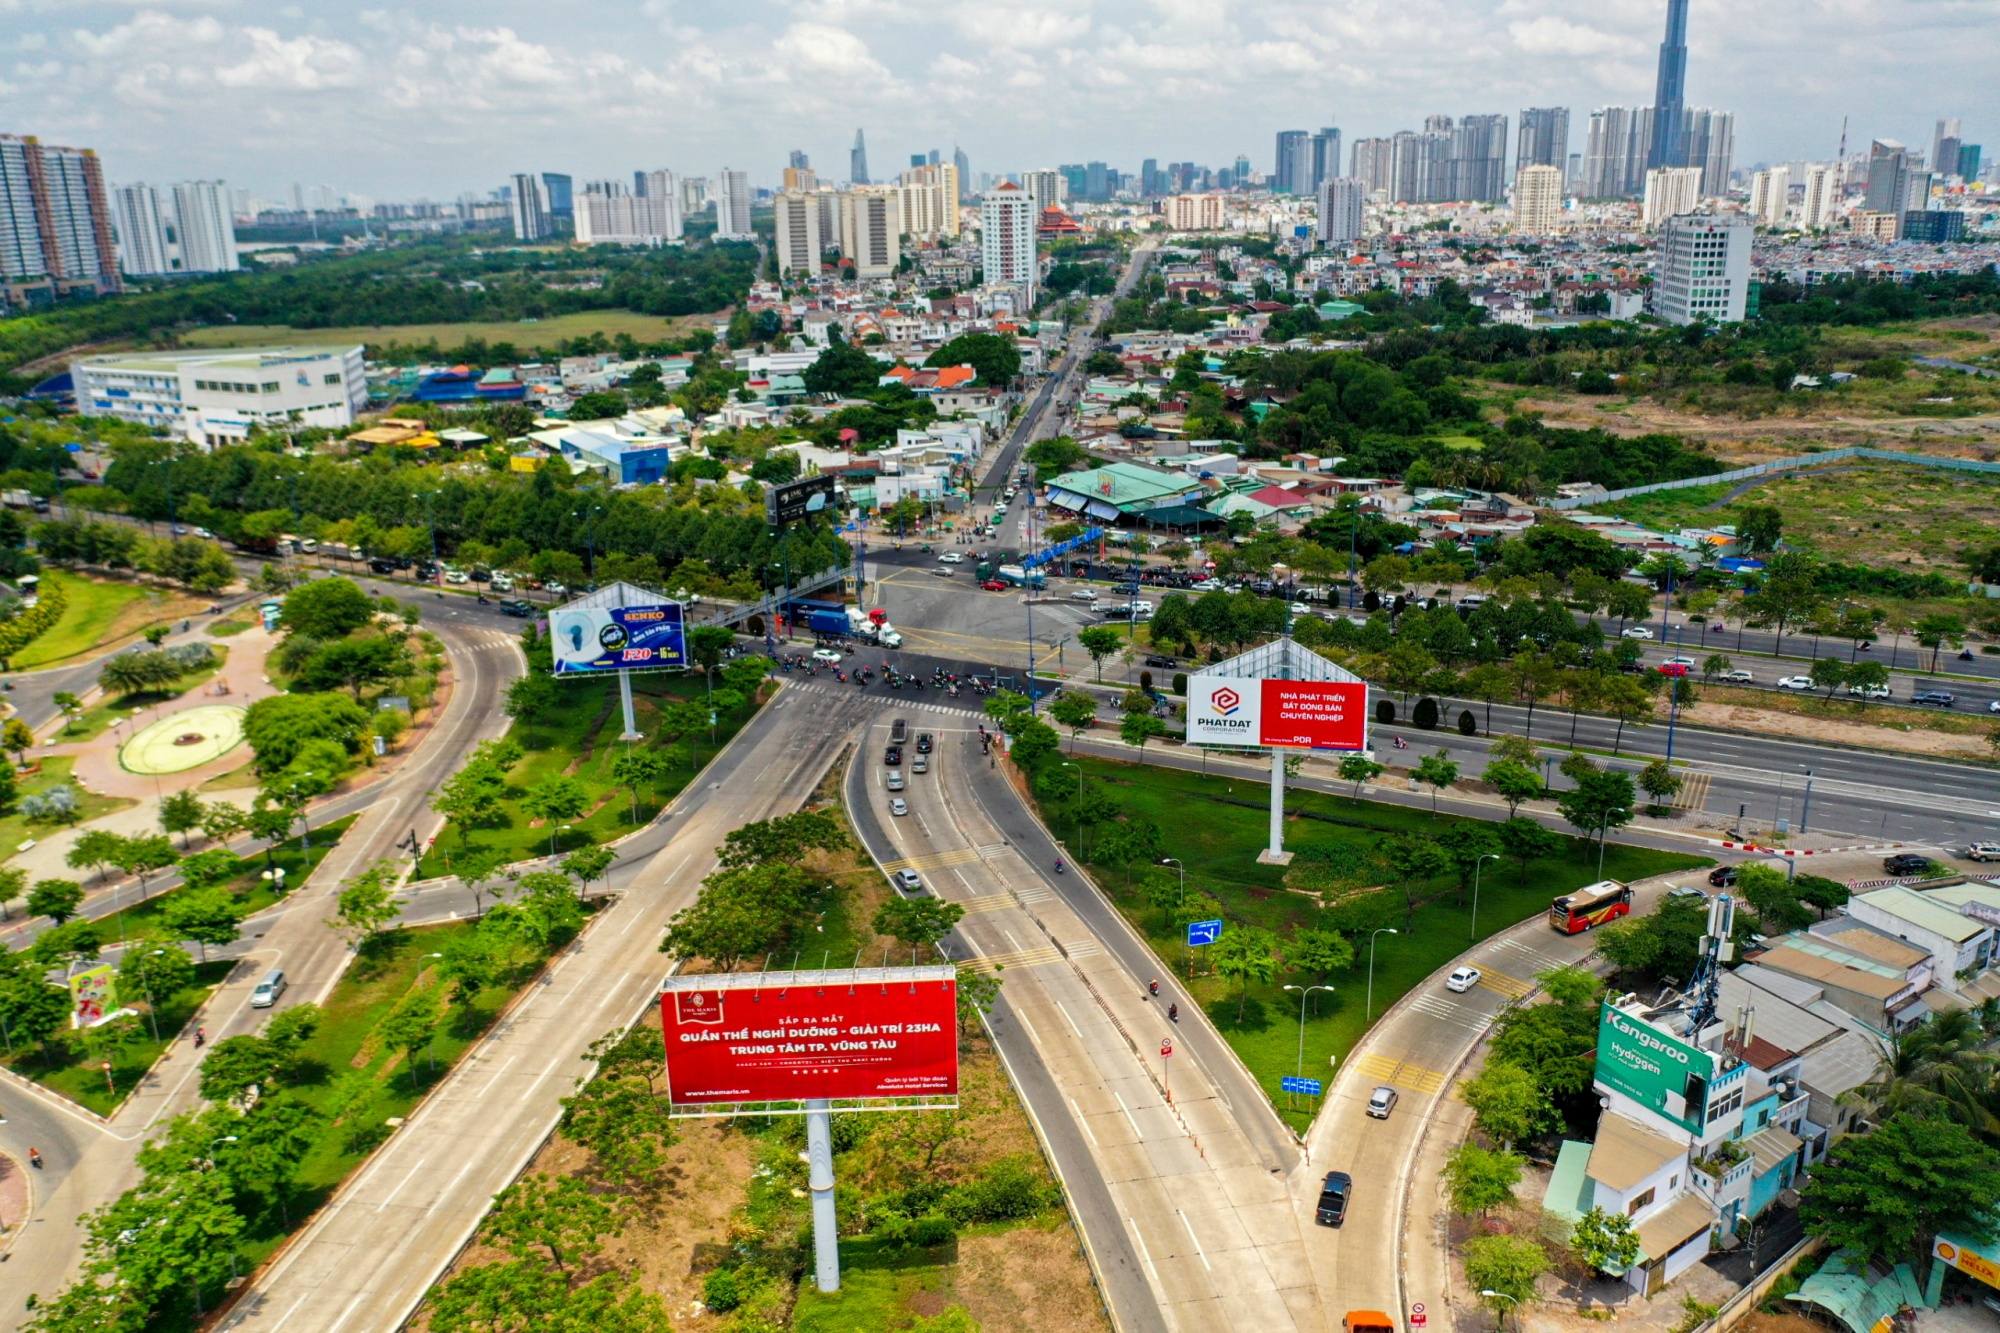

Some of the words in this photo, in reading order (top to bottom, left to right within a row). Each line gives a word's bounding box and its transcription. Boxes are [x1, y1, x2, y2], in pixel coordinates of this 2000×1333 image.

[624, 611, 665, 621] SENKO
[622, 648, 652, 661] F20
[1280, 692, 1298, 700] NHÀ
[1280, 712, 1313, 720] CHUYÊN
[1197, 718, 1252, 728] PHATDAT
[1293, 735, 1312, 744] PDR
[778, 1016, 800, 1025] SẮP
[822, 1014, 844, 1023] MẮT
[789, 1026, 838, 1038] DƯỠNG
[849, 1023, 878, 1035] GIẢI
[880, 1022, 903, 1034] TRÍ
[905, 1023, 941, 1033] 23HA
[1605, 1011, 1689, 1064] Kangaroo
[729, 1044, 775, 1055] TRUNG
[777, 1042, 805, 1053] TÂM
[807, 1043, 828, 1052] TP.
[830, 1040, 868, 1050] VŨNG
[870, 1038, 897, 1050] TÀU
[1611, 1041, 1660, 1075] Hydrogen
[685, 1089, 750, 1097] www.themaris.vn
[1961, 1256, 1996, 1280] HELIX
